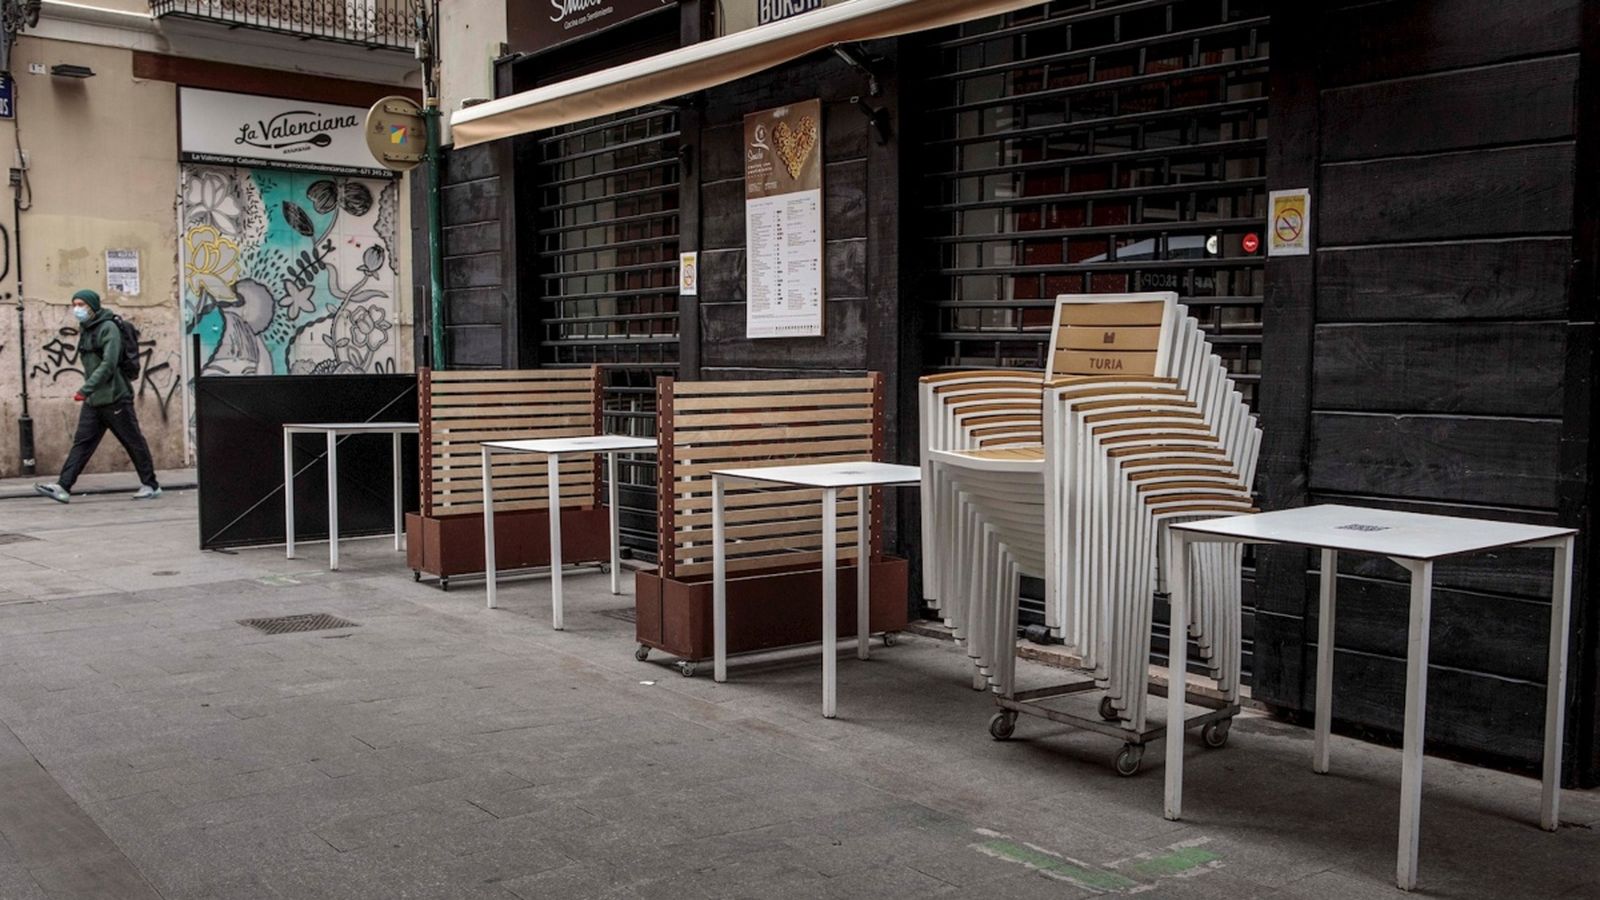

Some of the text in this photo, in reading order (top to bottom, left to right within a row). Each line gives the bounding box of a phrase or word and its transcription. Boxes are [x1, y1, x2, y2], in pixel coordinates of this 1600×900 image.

[234, 123, 258, 145] La
[258, 111, 359, 141] Valenciana
[200, 154, 234, 163] Valenciana
[1089, 358, 1124, 370] TURIA
